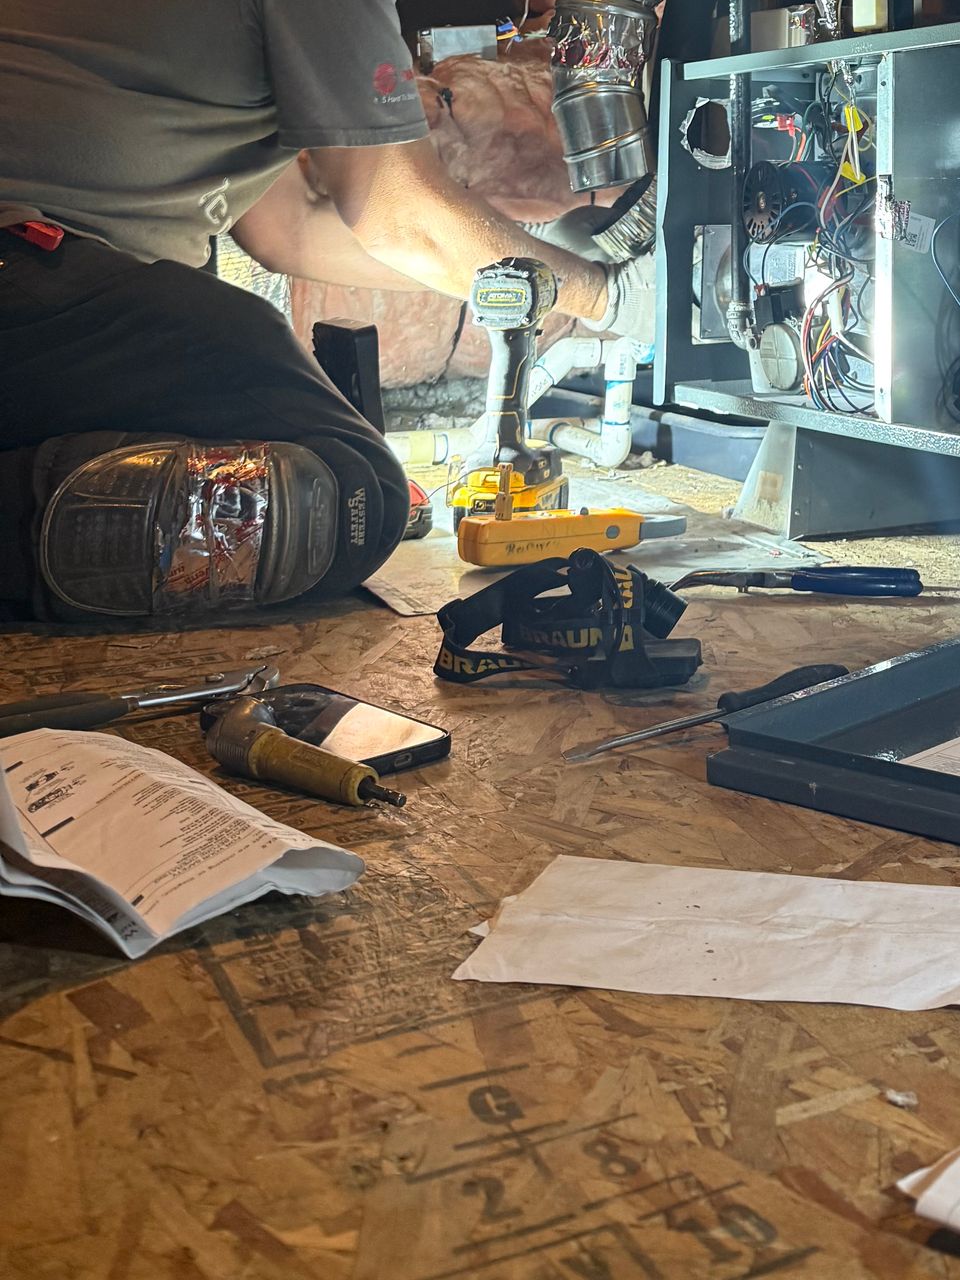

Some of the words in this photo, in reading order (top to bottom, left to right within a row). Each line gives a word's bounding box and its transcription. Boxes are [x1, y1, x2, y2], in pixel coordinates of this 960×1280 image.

[348, 497, 359, 544] SAFETY
[354, 487, 366, 546] WESTERN
[468, 1084, 525, 1125] G
[582, 1136, 643, 1180] 8
[461, 1176, 524, 1223] 2
